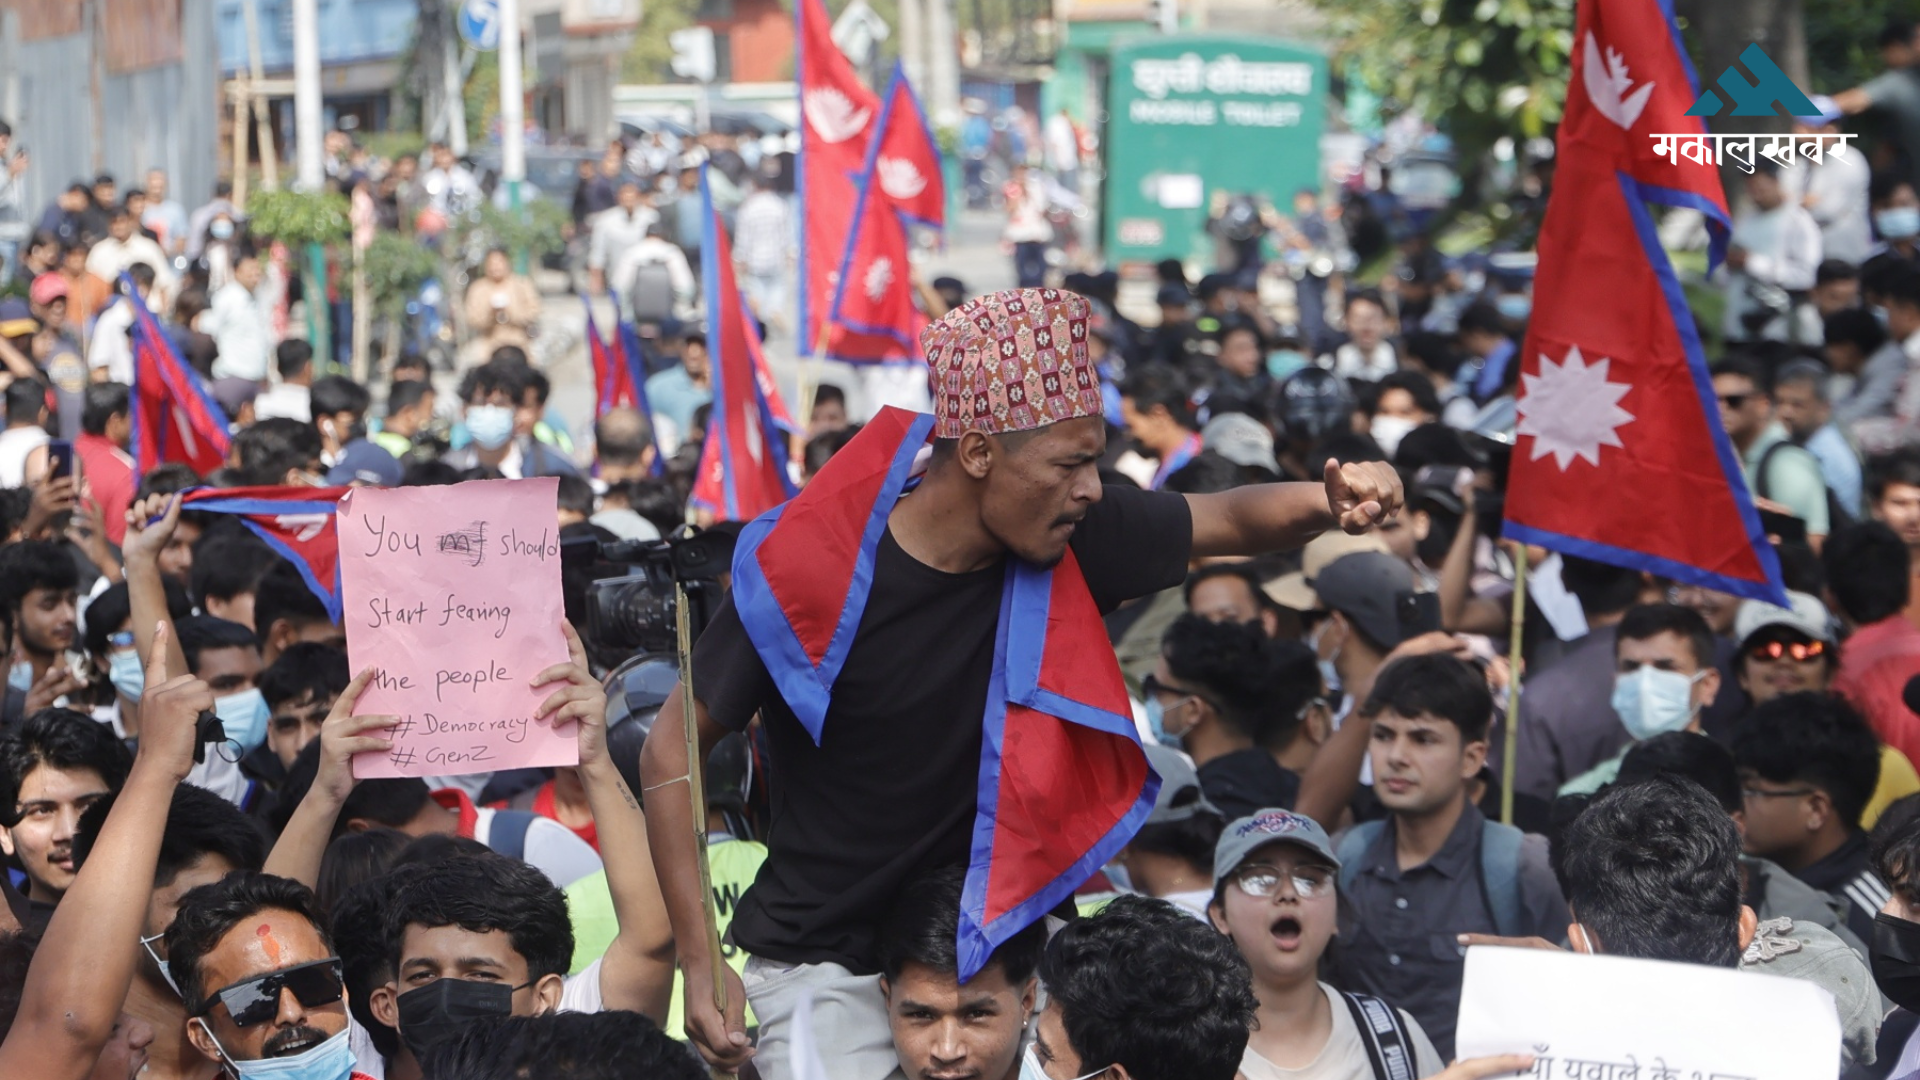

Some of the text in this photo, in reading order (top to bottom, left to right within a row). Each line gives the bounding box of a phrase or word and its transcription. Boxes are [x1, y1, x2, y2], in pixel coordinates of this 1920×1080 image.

[1130, 99, 1302, 126] MOBILE TOILET
[364, 514, 422, 557] You
[500, 528, 560, 561] should
[438, 594, 511, 638] fearing
[373, 660, 514, 702] the people
[1362, 1000, 1394, 1034] PUMA
